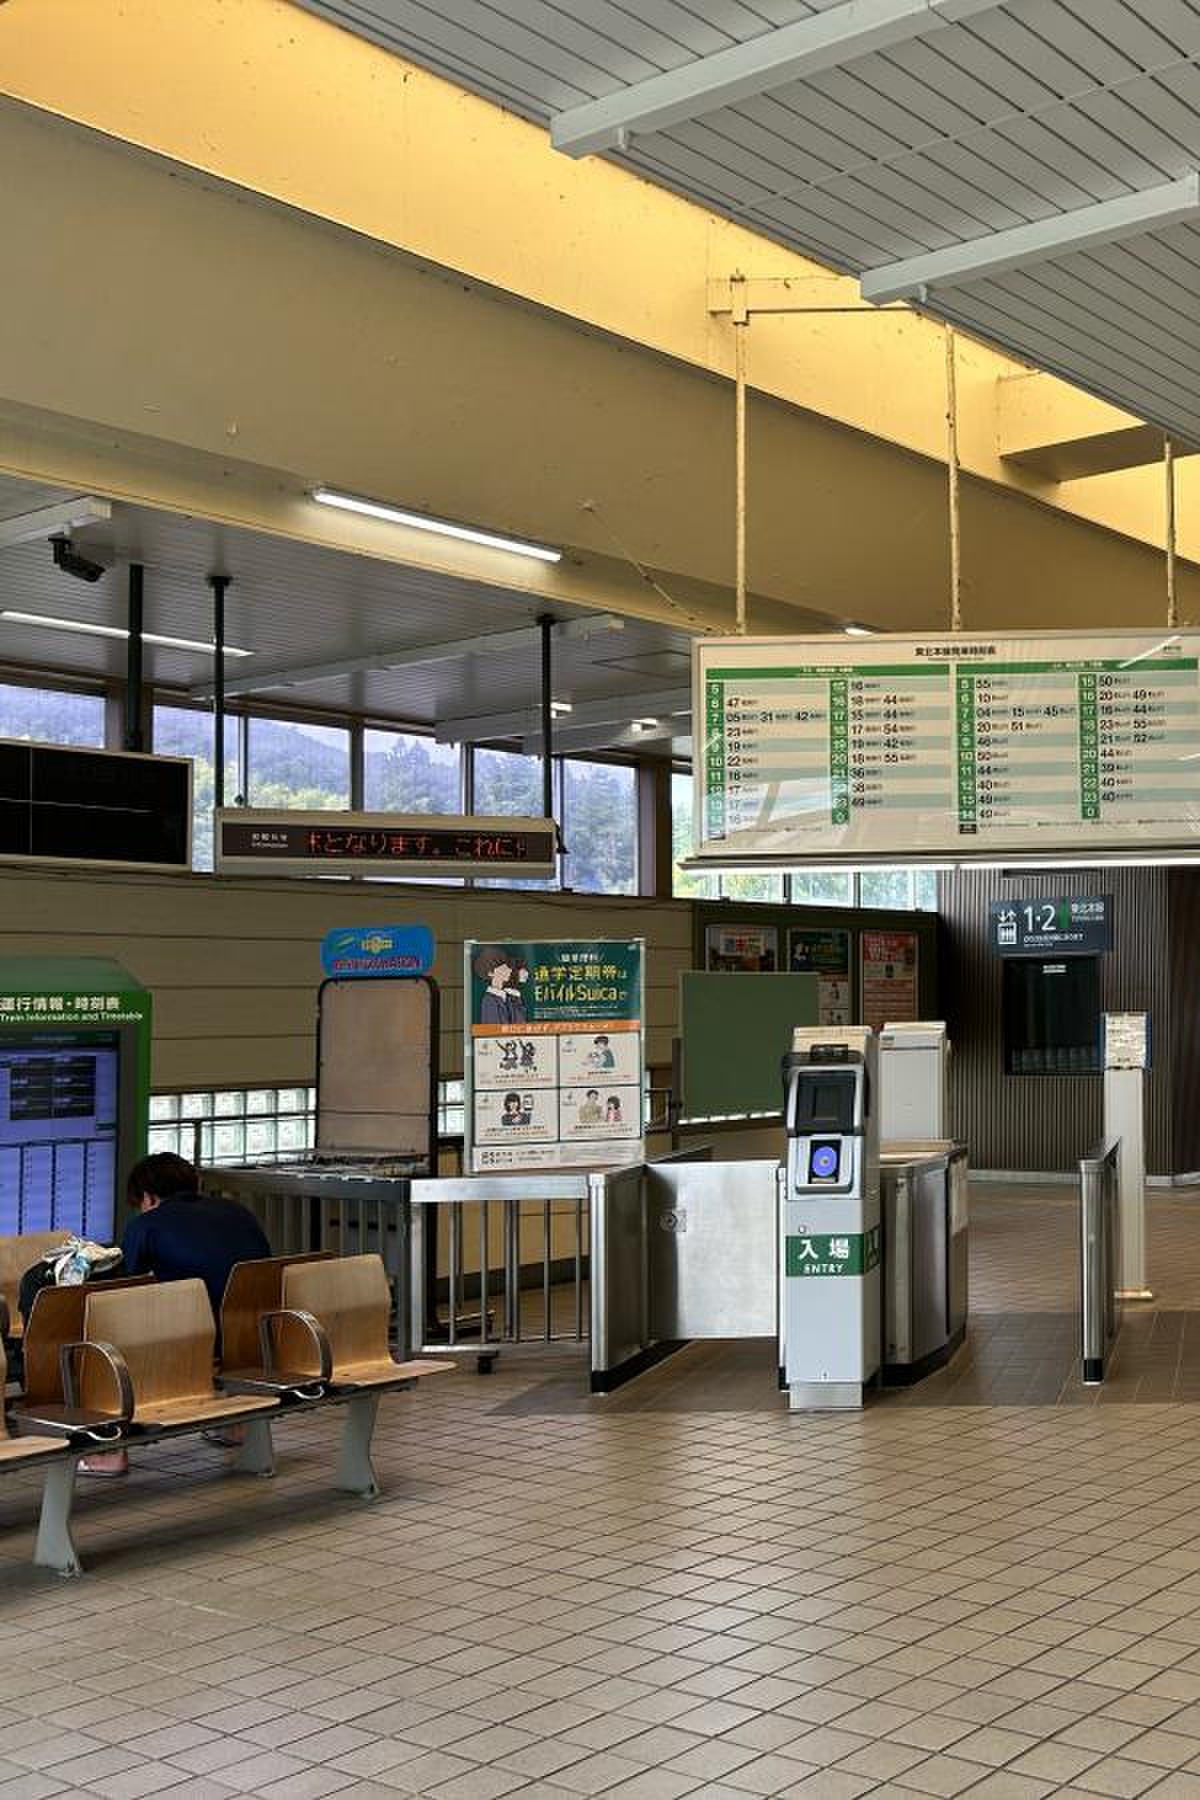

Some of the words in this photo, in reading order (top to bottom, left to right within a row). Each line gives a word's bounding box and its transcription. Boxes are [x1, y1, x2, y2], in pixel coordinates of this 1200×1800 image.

[961, 709, 970, 719] 7
[727, 756, 741, 767] 22
[534, 965, 628, 982] 通学定期券は
[534, 984, 628, 1002] モバイルSuicaで
[27, 1011, 78, 1021] Information
[81, 1012, 98, 1021] and
[798, 1238, 850, 1260] 入場
[803, 1263, 844, 1273] ENTRY
